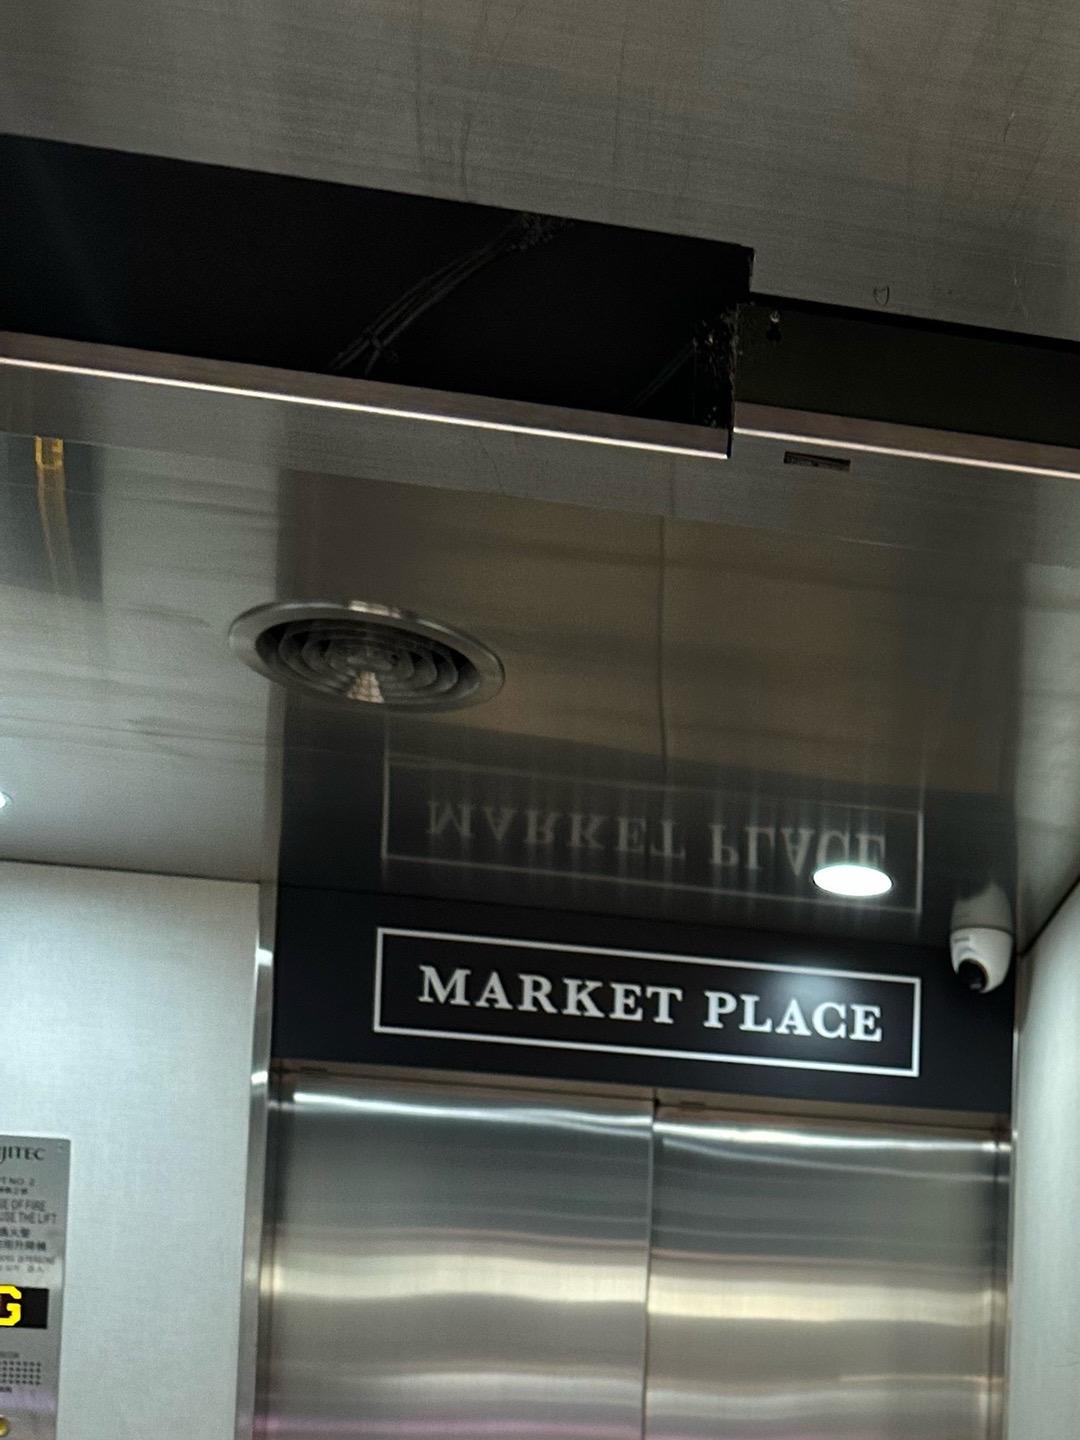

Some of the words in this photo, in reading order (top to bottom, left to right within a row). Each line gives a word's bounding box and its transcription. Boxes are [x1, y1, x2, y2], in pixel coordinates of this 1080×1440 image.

[419, 964, 683, 1025] MARKET
[704, 990, 883, 1042] PLACE
[0, 1146, 46, 1164] JITEC
